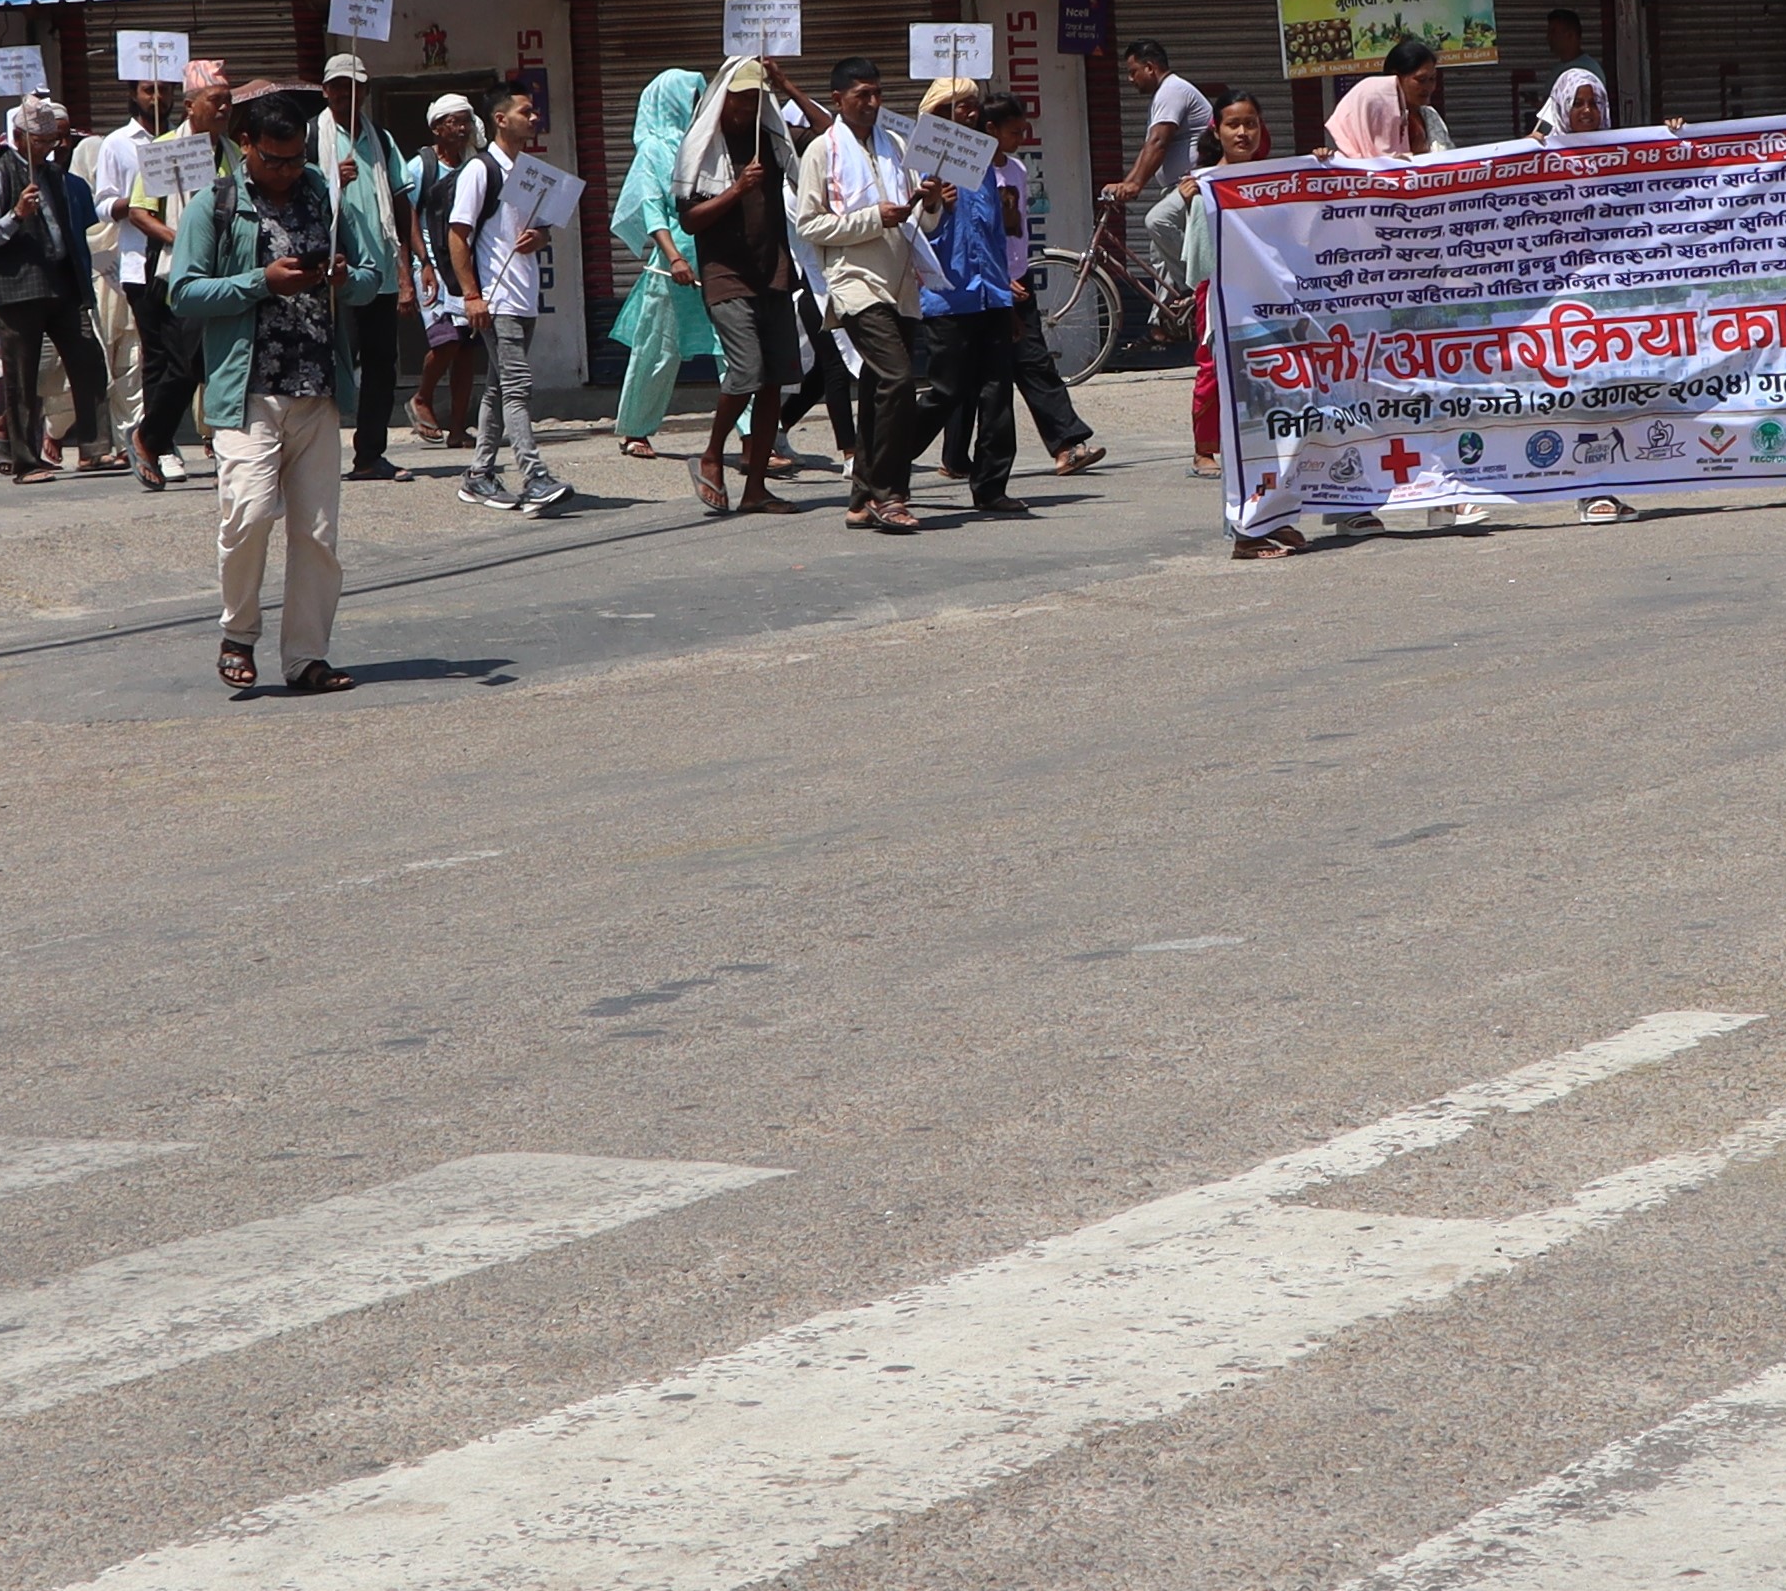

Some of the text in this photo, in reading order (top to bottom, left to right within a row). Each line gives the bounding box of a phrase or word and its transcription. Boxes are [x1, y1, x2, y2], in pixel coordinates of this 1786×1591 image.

[1065, 7, 1090, 17] Ncell
[1305, 174, 1400, 197] बलपूर्वक
[1457, 162, 1494, 184] पार्ने
[1494, 157, 1541, 180] कार्य
[1633, 148, 1661, 165] १४
[1369, 199, 1446, 221] पारिएका
[1578, 178, 1644, 201] अवस्था
[1647, 173, 1718, 195] तत्काल
[1502, 203, 1593, 230] शक्तिशाली
[1648, 194, 1715, 215] आयोग
[1717, 192, 1766, 212] गठन
[1316, 244, 1394, 269] पीडितको
[1516, 236, 1533, 254] र
[1532, 220, 1654, 250] अभियोजनको
[1357, 267, 1385, 287] ऐन
[1387, 259, 1515, 283] कार्यान्वयनमा
[1517, 255, 1557, 279] द्वन्द्व
[1676, 236, 1774, 259] सहभागिता
[1405, 282, 1484, 304] सहितको
[1486, 276, 1539, 299] पीडित
[1614, 260, 1758, 288] संक्रमणकालीन
[1438, 399, 1472, 419] १४
[1475, 387, 1522, 415] गते
[1580, 381, 1669, 409] अगस्ट
